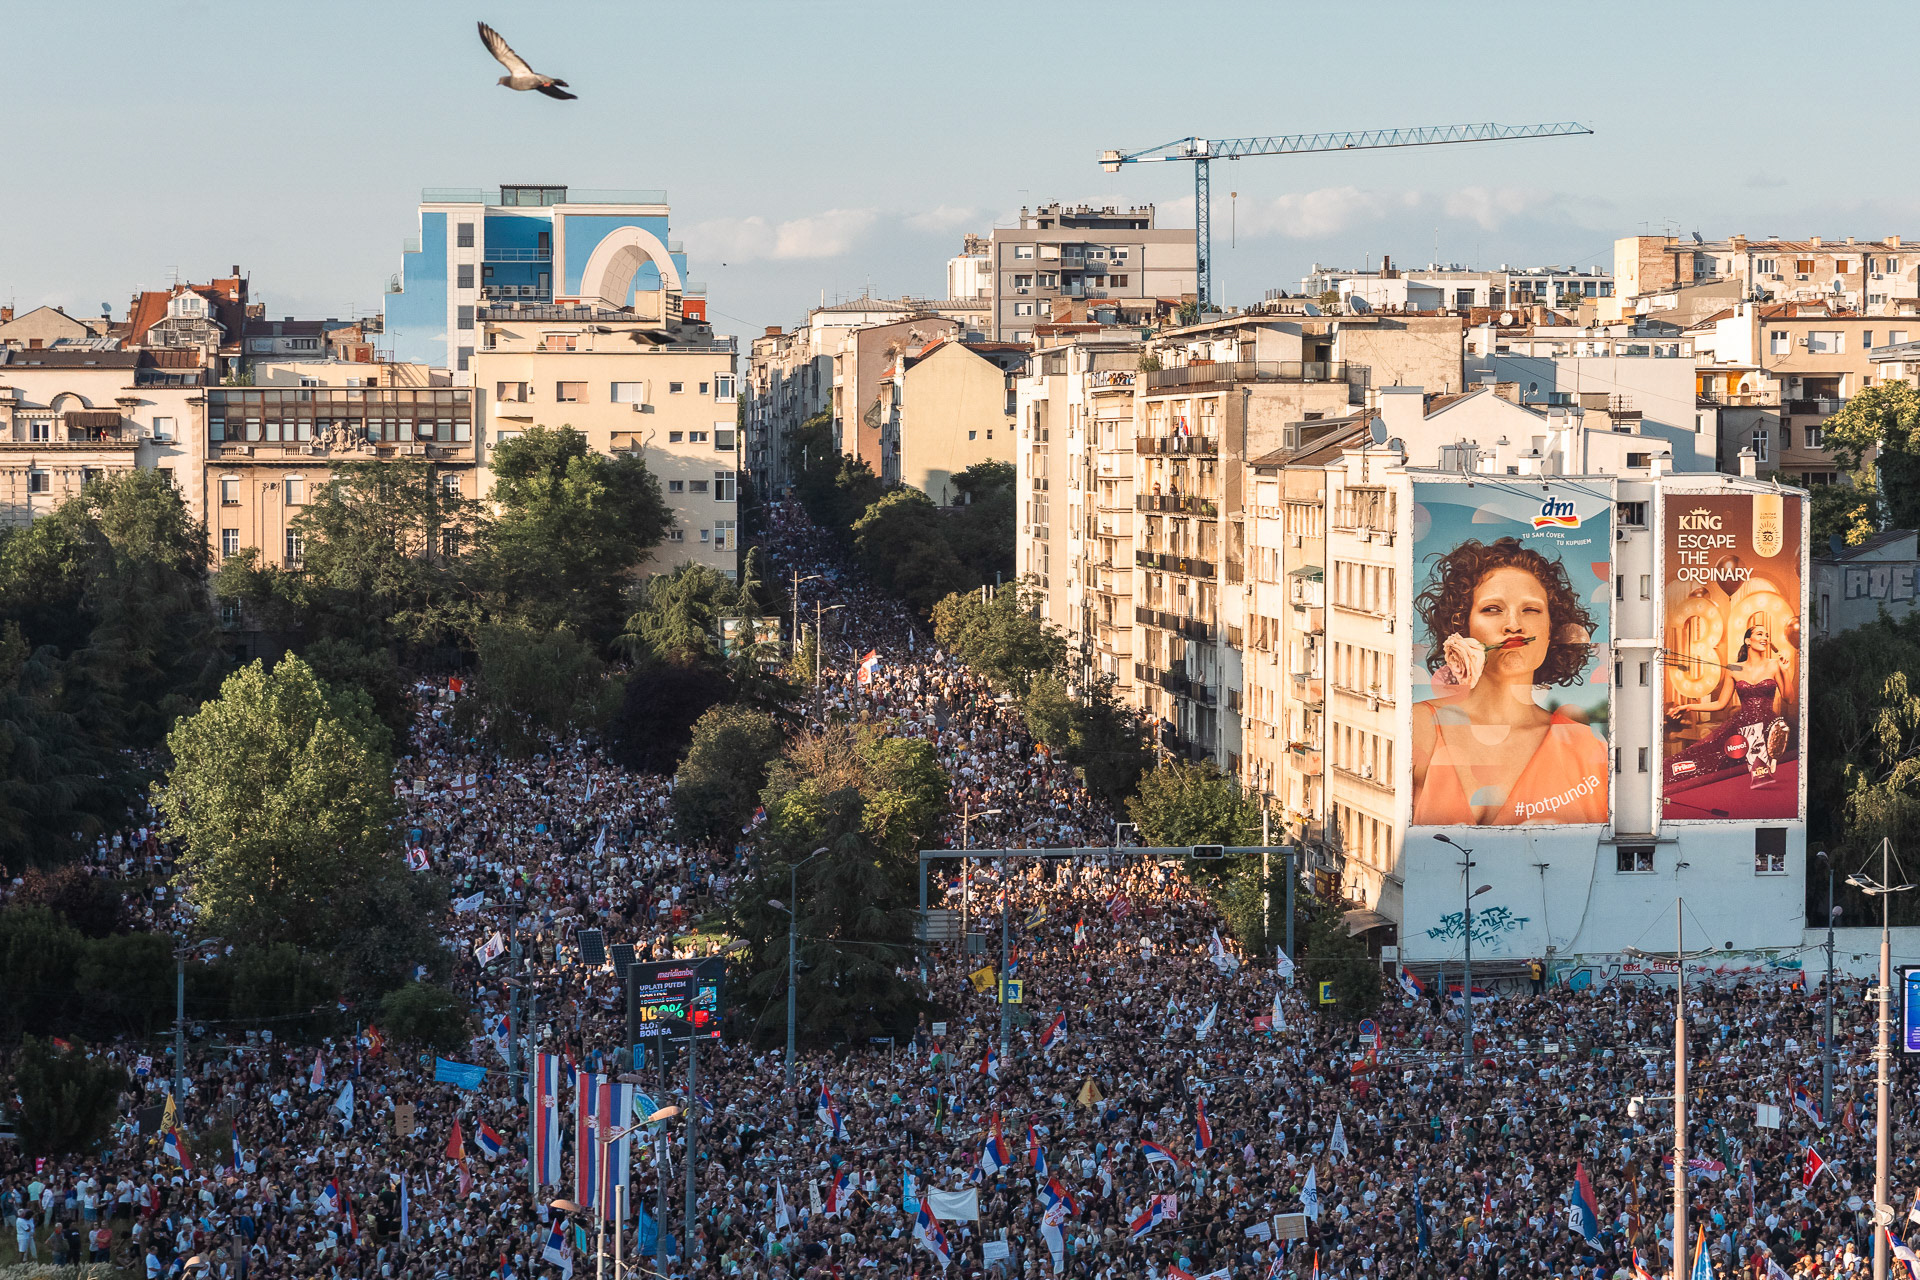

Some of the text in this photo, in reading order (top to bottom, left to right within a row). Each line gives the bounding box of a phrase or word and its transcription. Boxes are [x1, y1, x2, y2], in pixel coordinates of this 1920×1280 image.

[1542, 497, 1574, 516] dm
[1678, 515, 1723, 530] KING
[1565, 538, 1592, 546] KUPUJEM
[1678, 534, 1736, 550] ESCAPE
[1677, 551, 1709, 565] THE
[1677, 567, 1754, 585] ORDINARY
[1727, 742, 1747, 752] Novo!
[1752, 766, 1769, 777] KING
[1515, 775, 1600, 819] #potpunoja
[658, 968, 694, 978] meridianbe
[664, 981, 686, 989] PUTEM
